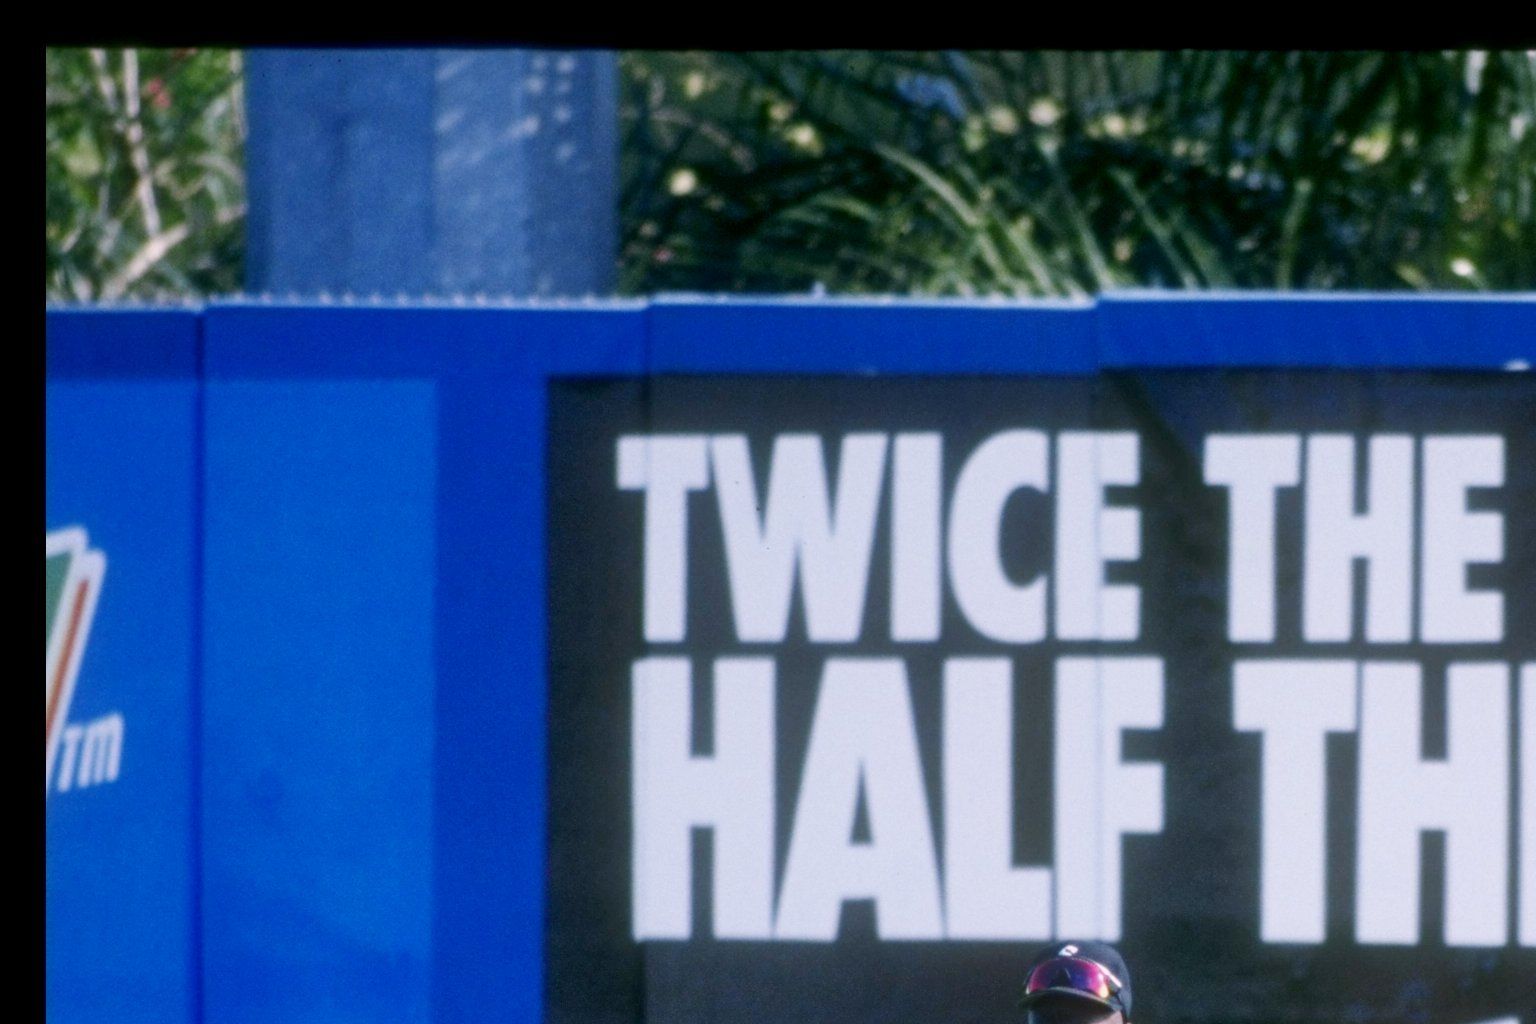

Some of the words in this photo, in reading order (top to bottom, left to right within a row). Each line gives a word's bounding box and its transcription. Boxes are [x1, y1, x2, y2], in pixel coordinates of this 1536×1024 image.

[616, 428, 1142, 646] TWICE
[1203, 432, 1507, 646] THE
[630, 655, 1167, 943] HALF
